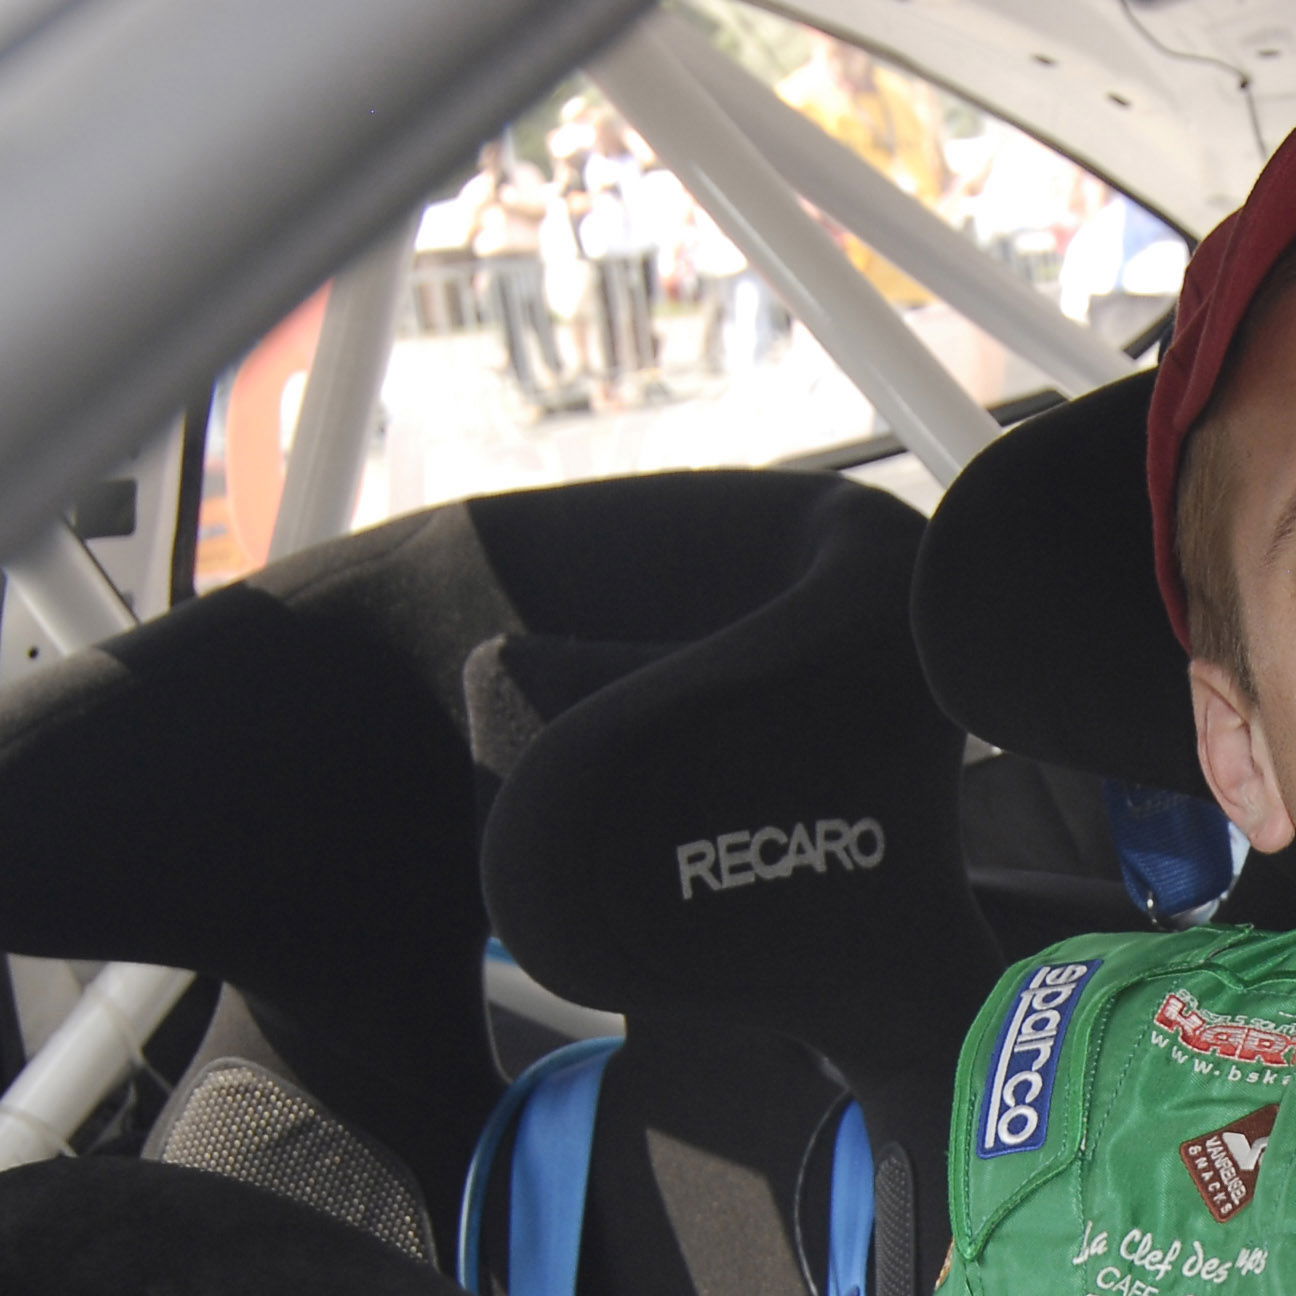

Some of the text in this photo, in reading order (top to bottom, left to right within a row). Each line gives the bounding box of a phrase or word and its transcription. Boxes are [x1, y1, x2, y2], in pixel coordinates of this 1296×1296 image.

[677, 817, 885, 900] RECARO
[990, 964, 1088, 1146] sparco
[1188, 1144, 1233, 1214] SNACKS
[1119, 1228, 1182, 1281] Clef
[1182, 1240, 1233, 1284] des
